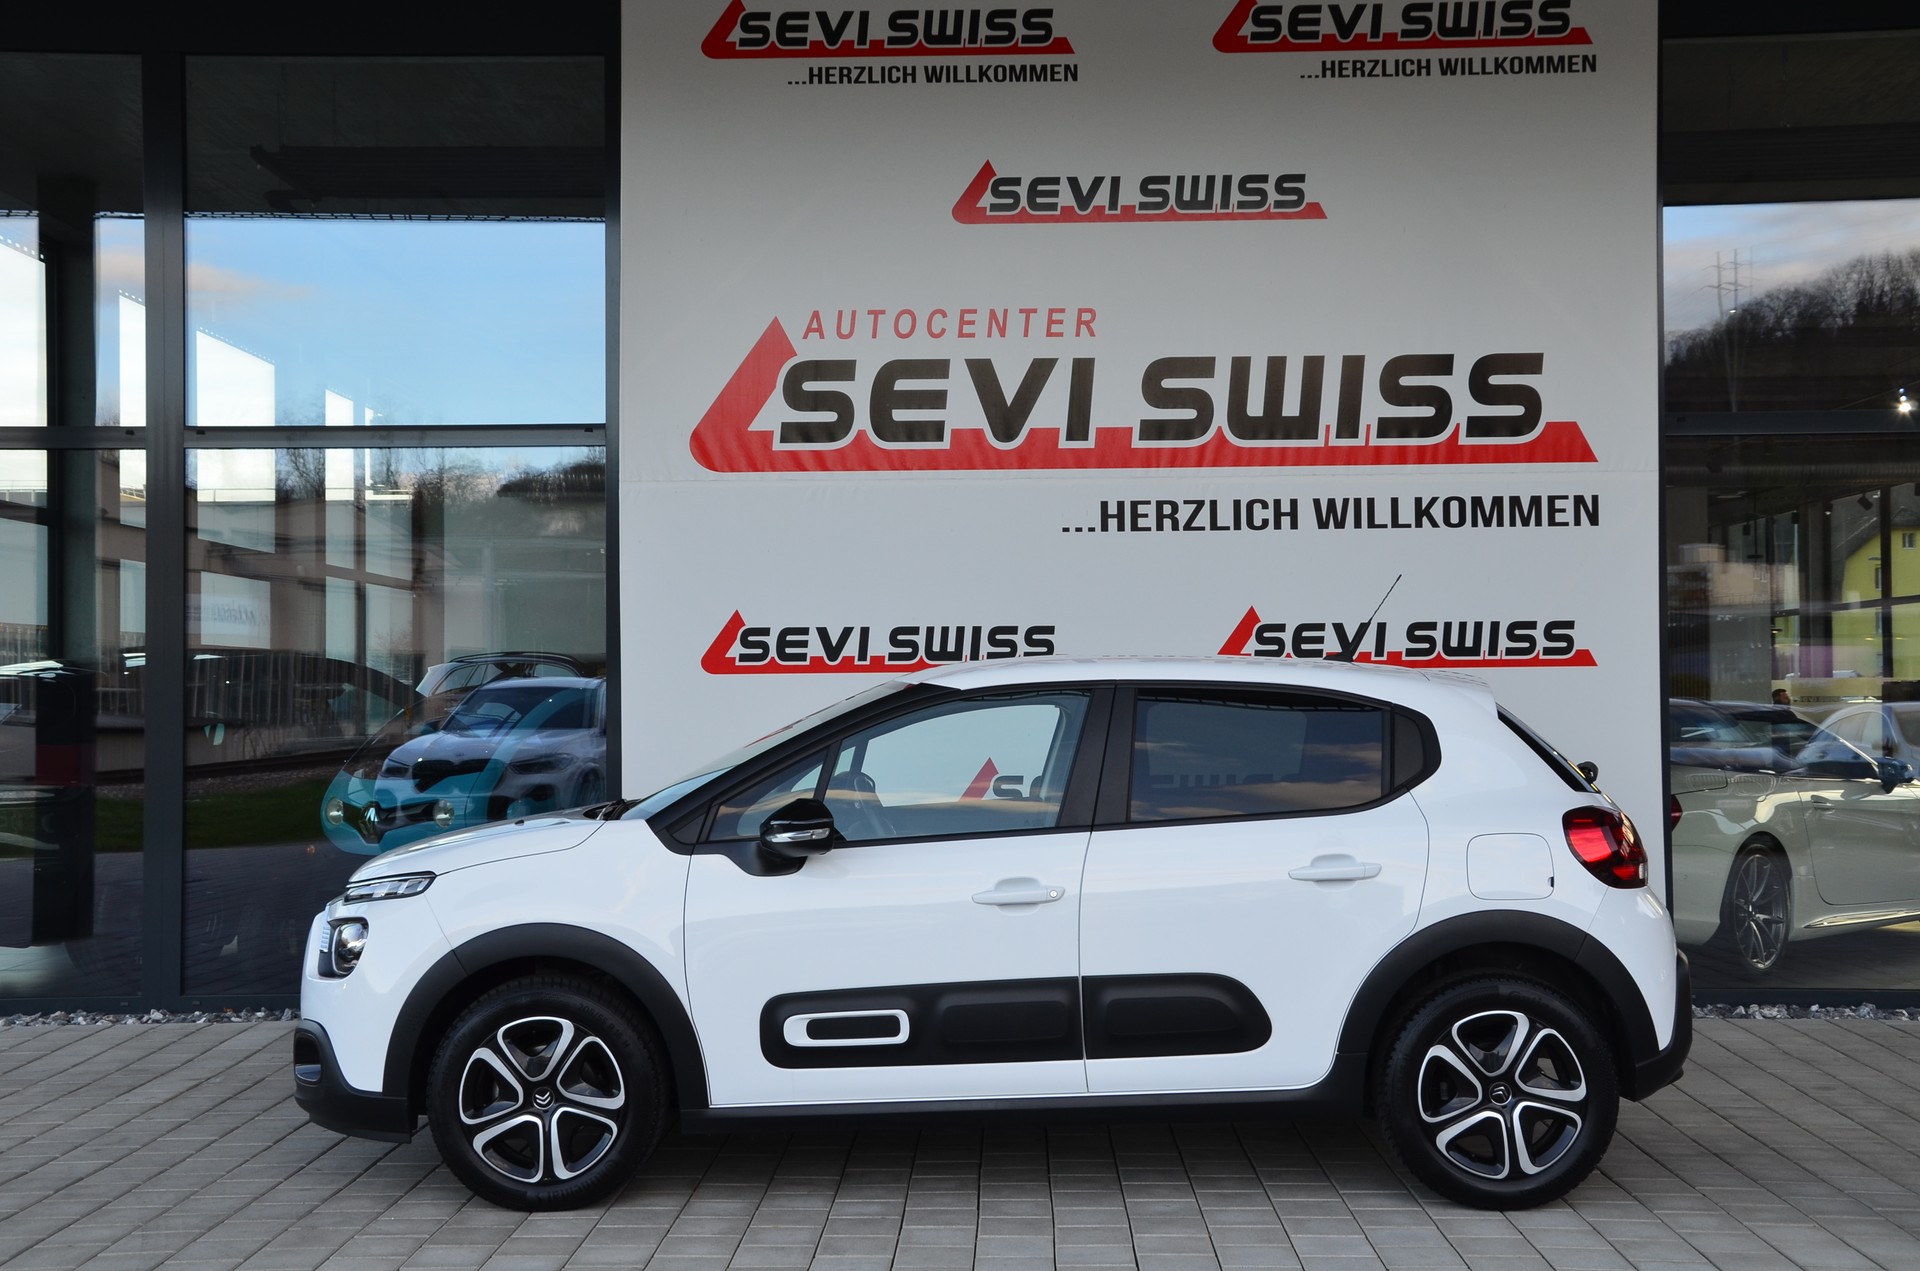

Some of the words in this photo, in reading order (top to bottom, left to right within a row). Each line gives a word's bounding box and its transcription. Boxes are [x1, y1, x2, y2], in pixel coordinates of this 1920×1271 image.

[738, 11, 870, 48] SEVI
[886, 8, 1054, 47] SWISS
[1250, 3, 1383, 42] SEVI
[1400, 0, 1572, 40] SWISS
[788, 65, 917, 85] ...HERZLICH
[924, 64, 1078, 84] WILLKOMMEN
[1300, 58, 1431, 79] ...HERZLICH
[1438, 54, 1597, 76] WILLKOMMEN
[989, 176, 1121, 213] SEVI
[1138, 174, 1306, 212] SWISS
[802, 307, 1097, 339] AUTOCENTER
[779, 357, 1096, 444] SEVI
[1138, 352, 1544, 441] SWISS
[1061, 498, 1299, 533] ...HERZLICH
[1312, 494, 1600, 530] WILLKOMMEN
[738, 626, 870, 663] SEVI
[887, 625, 1056, 662] SWISS
[1404, 620, 1576, 658] SWISS
